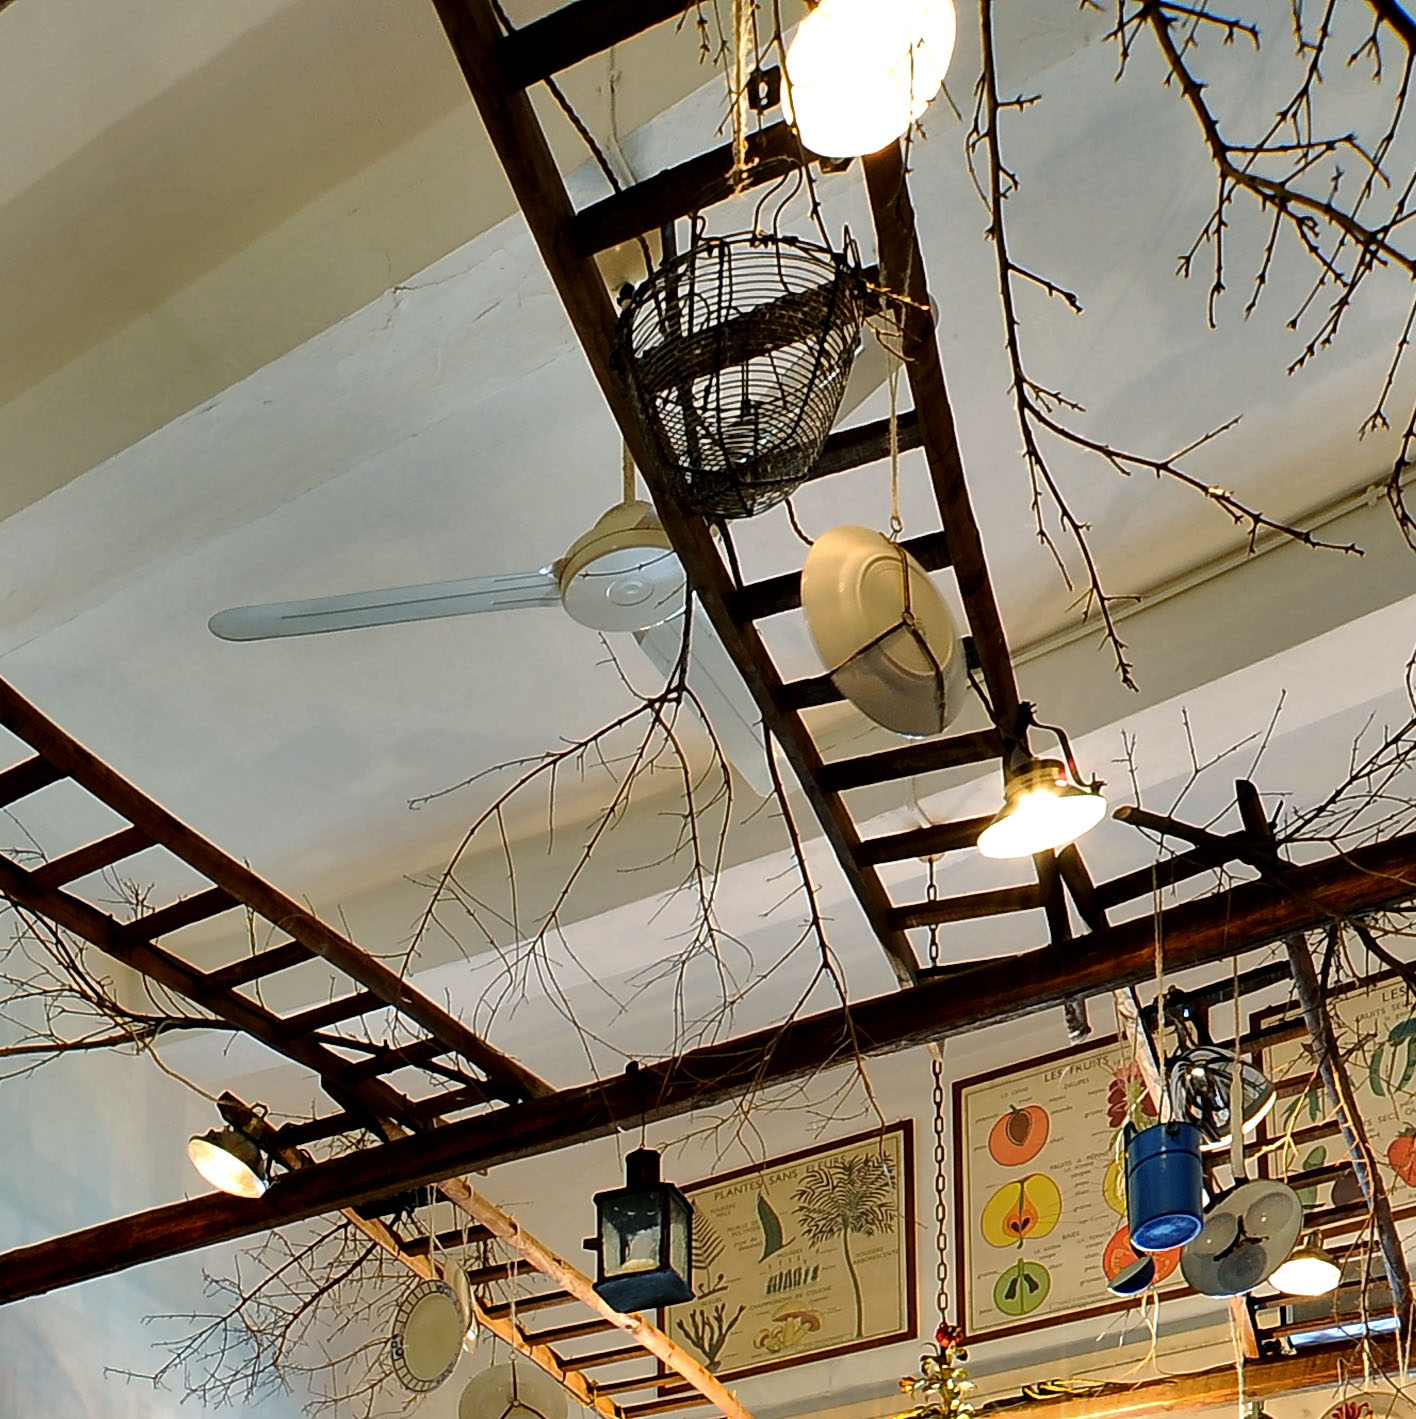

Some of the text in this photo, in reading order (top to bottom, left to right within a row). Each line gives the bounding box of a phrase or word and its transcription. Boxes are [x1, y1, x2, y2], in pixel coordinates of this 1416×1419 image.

[1069, 1055, 1110, 1075] FRUITS
[714, 1181, 763, 1201] PLANTES
[768, 1169, 798, 1187] SANS
